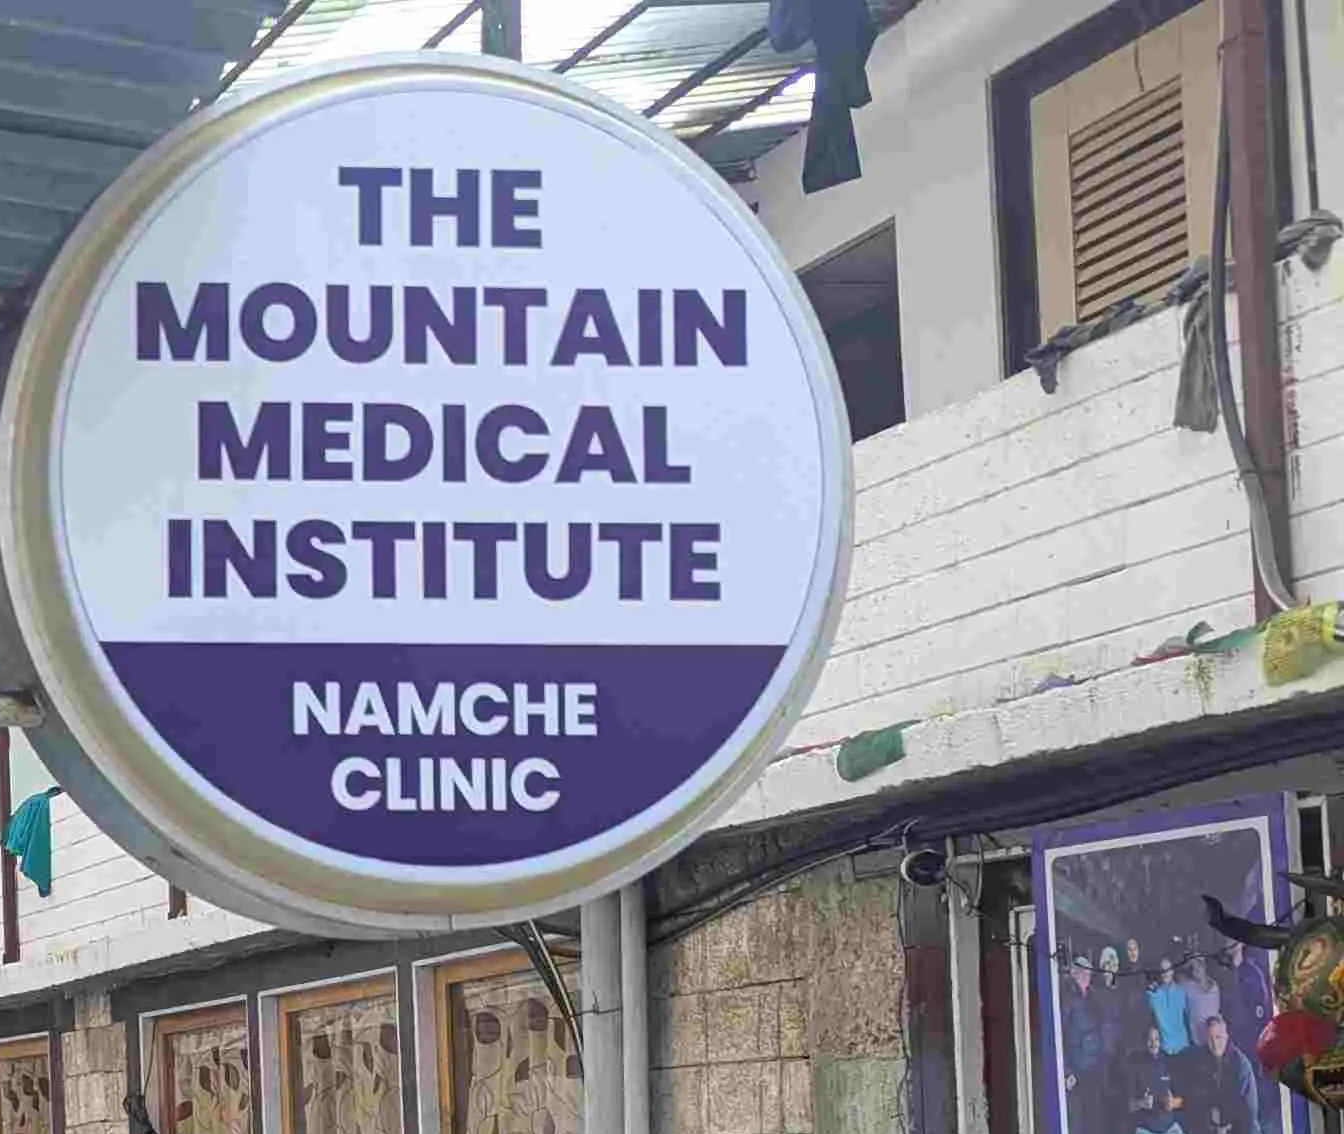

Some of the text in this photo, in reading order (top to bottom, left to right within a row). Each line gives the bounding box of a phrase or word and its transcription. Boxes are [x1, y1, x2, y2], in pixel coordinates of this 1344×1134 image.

[338, 166, 543, 249] THE
[135, 281, 748, 367] MOUNTAIN
[197, 401, 692, 484] MEDICAL
[166, 518, 721, 603] INSTITUTE
[292, 680, 598, 738] NAMCHE
[330, 756, 561, 813] CLINIC
